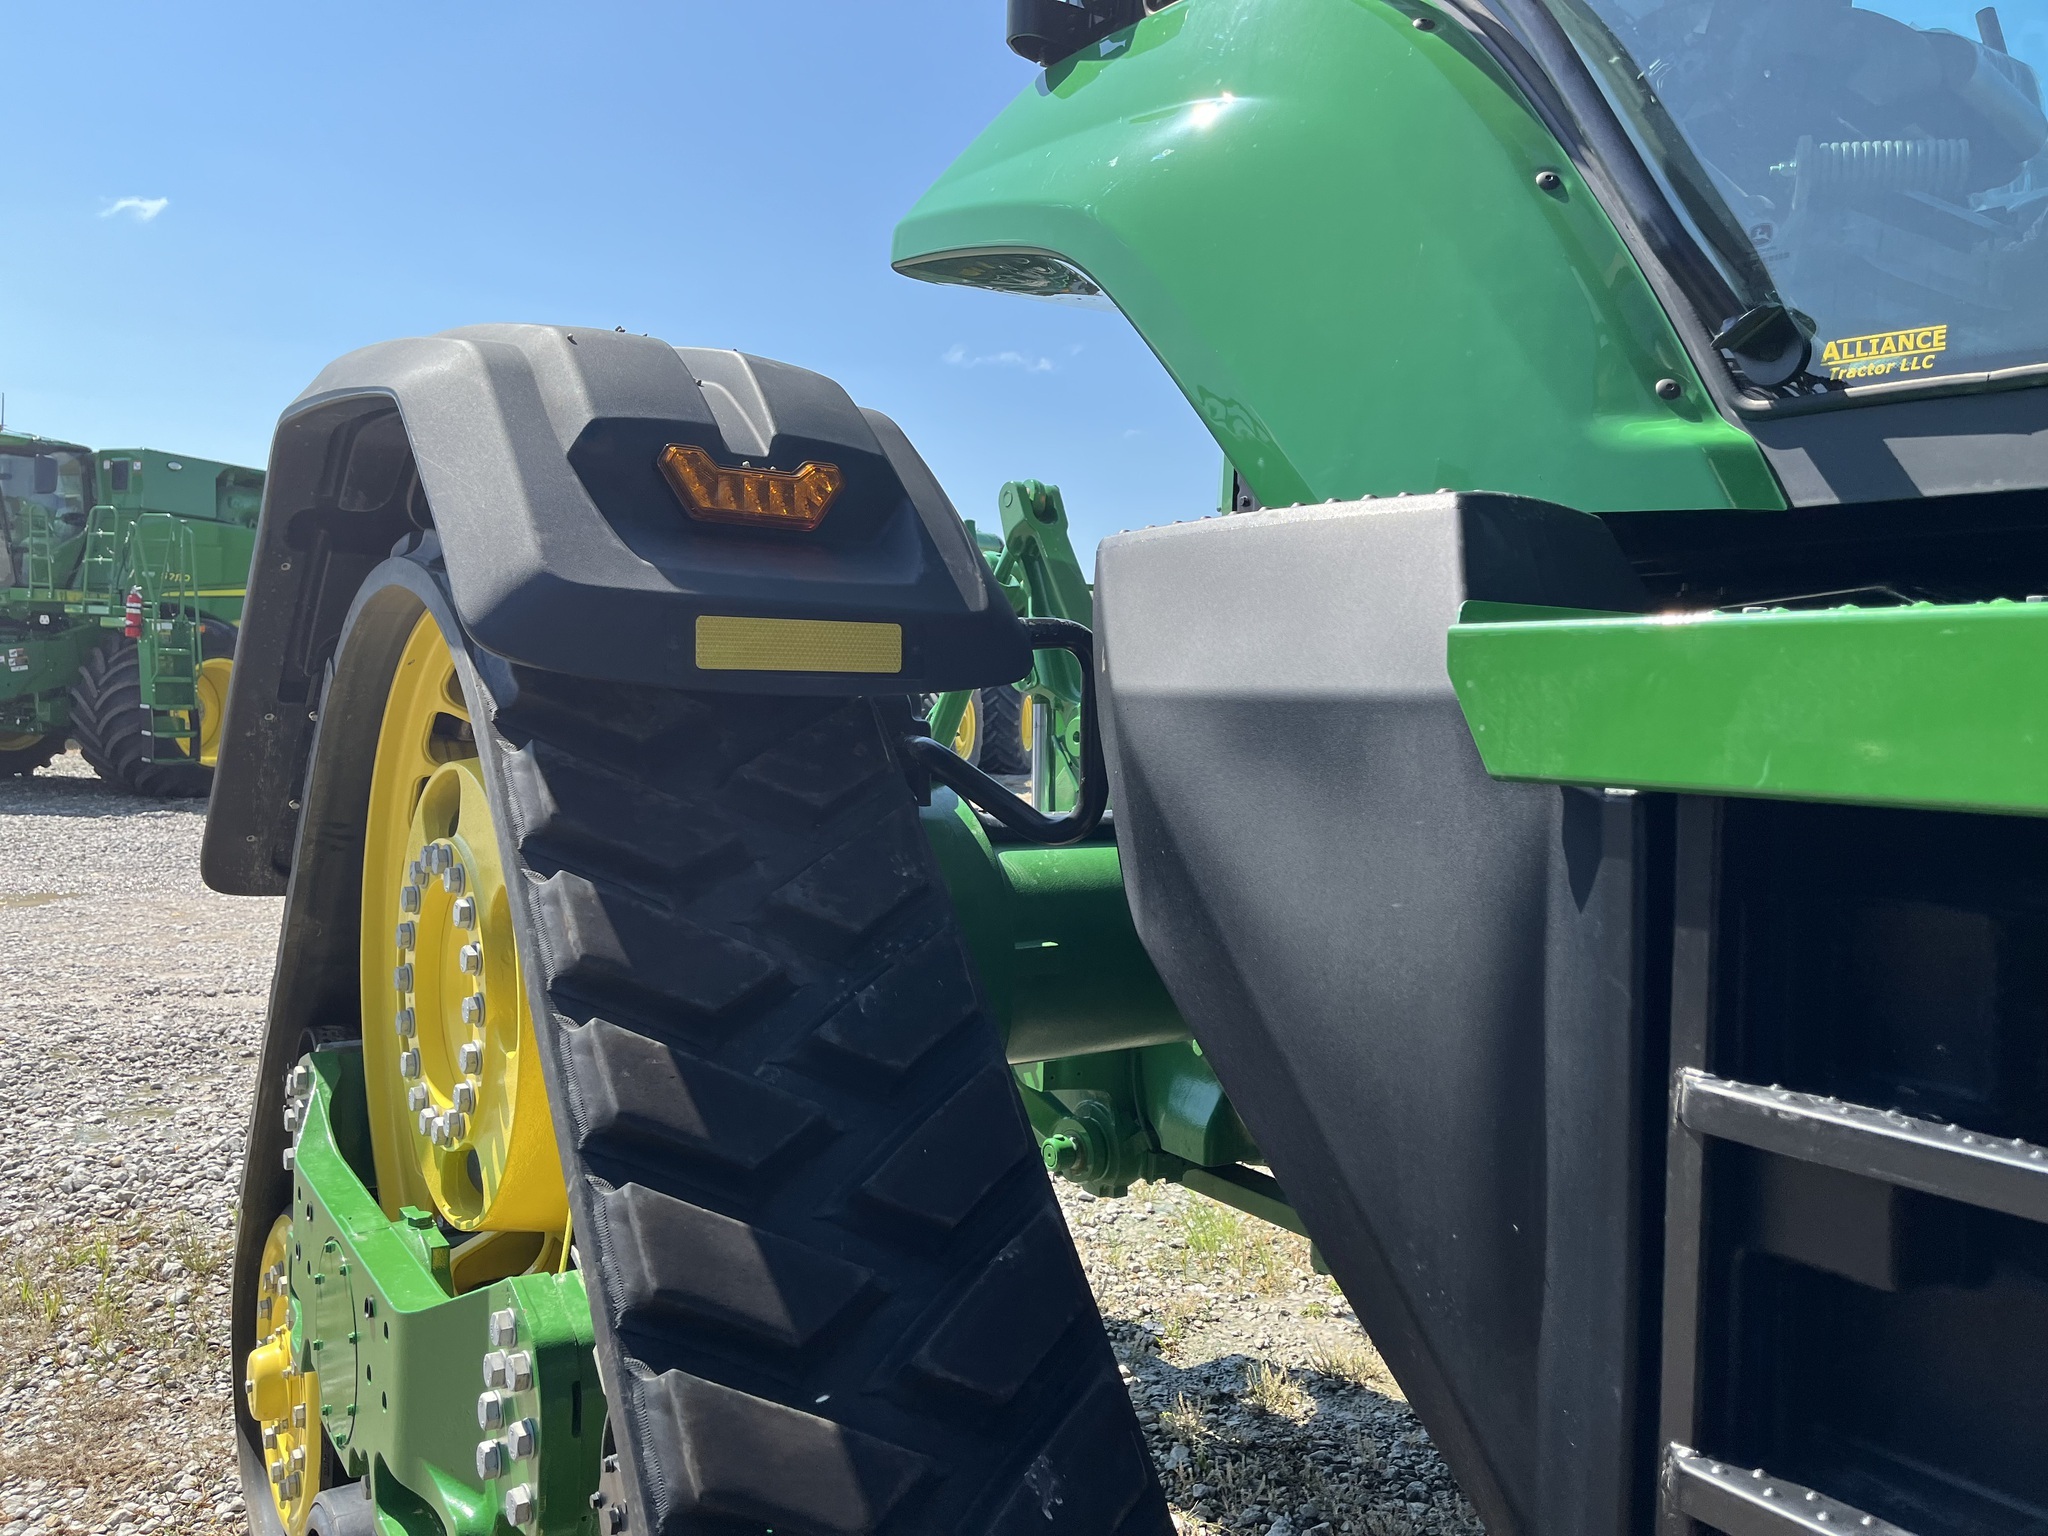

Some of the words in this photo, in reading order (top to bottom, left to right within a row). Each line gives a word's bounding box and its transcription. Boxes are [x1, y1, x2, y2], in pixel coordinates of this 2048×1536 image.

[1822, 328, 1947, 362] ALLIANCE
[1829, 361, 1895, 381] Tractor
[1899, 355, 1936, 372] LLC
